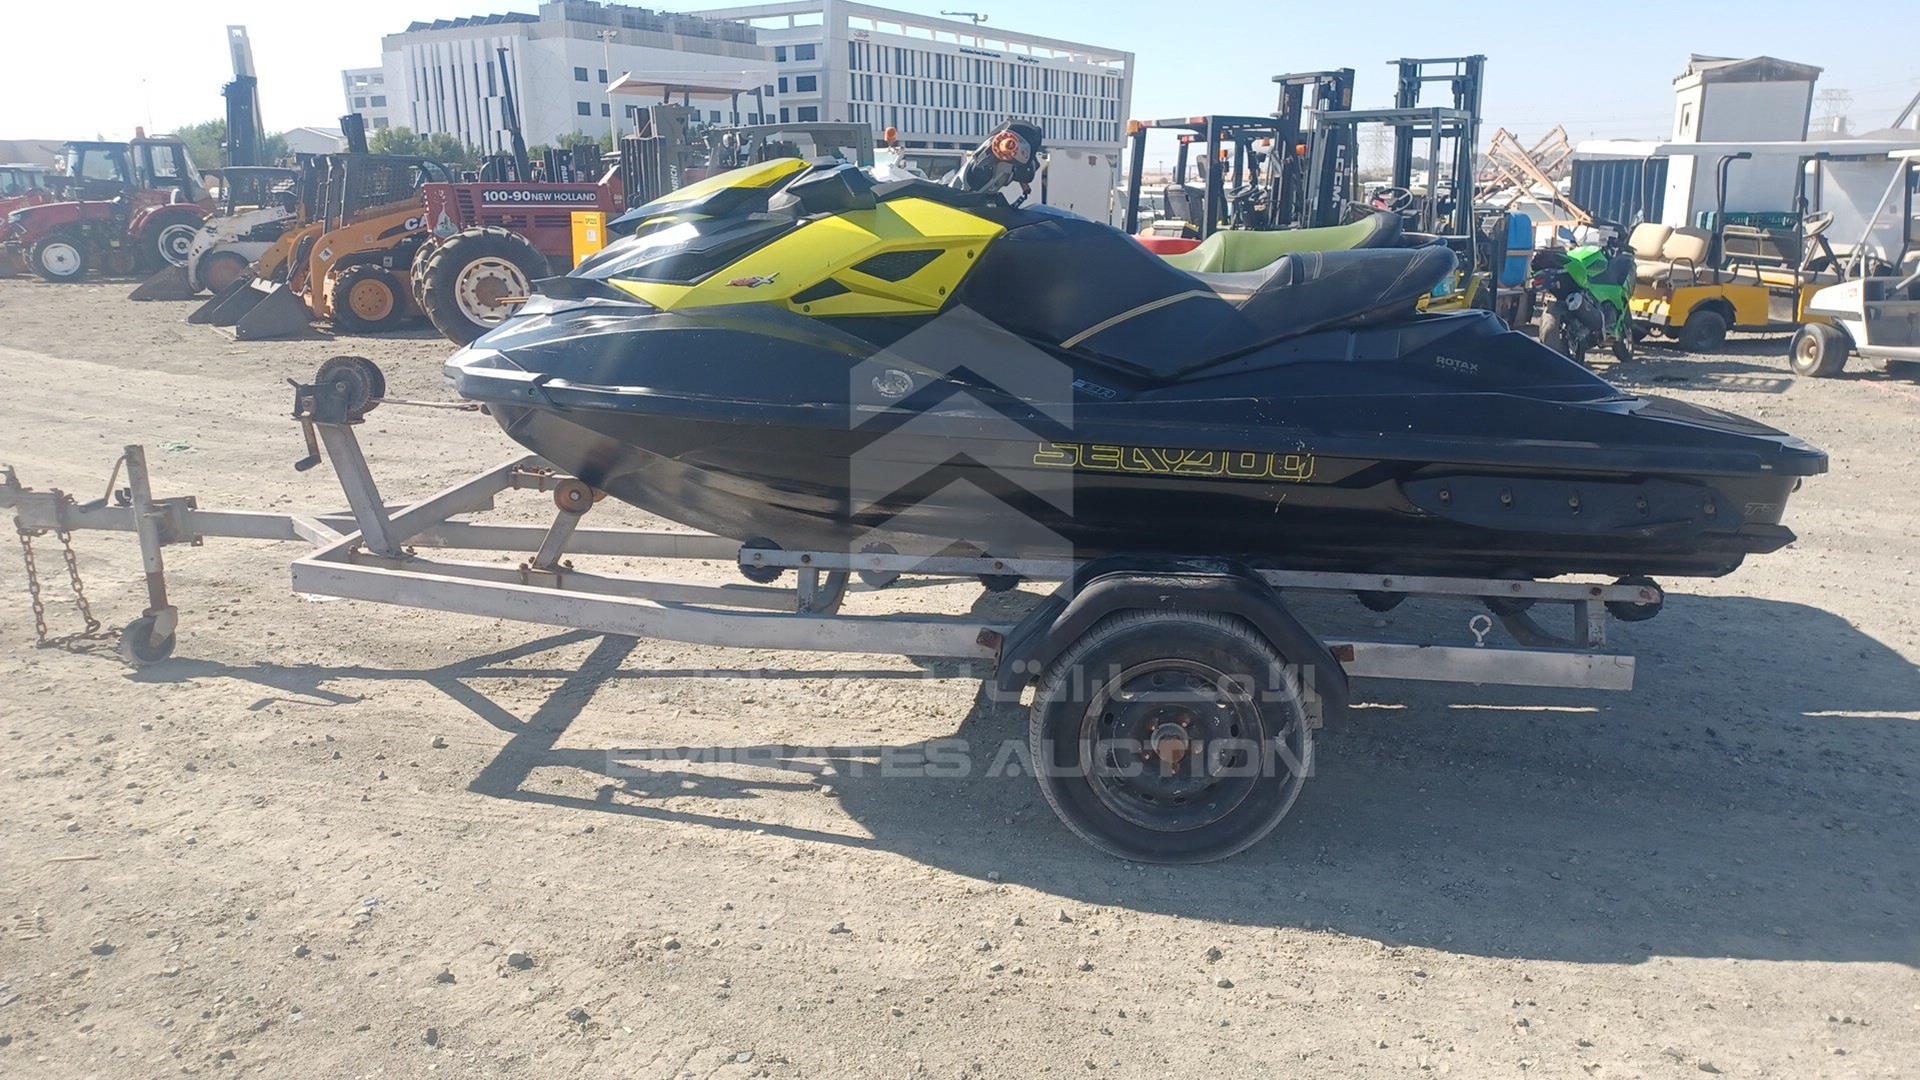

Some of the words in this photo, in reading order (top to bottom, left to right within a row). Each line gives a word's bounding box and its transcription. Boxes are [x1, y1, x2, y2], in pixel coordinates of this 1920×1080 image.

[483, 190, 531, 202] 100-90
[531, 192, 551, 202] NEW
[554, 192, 597, 202] HOLLAND
[1436, 356, 1479, 371] ROTAX
